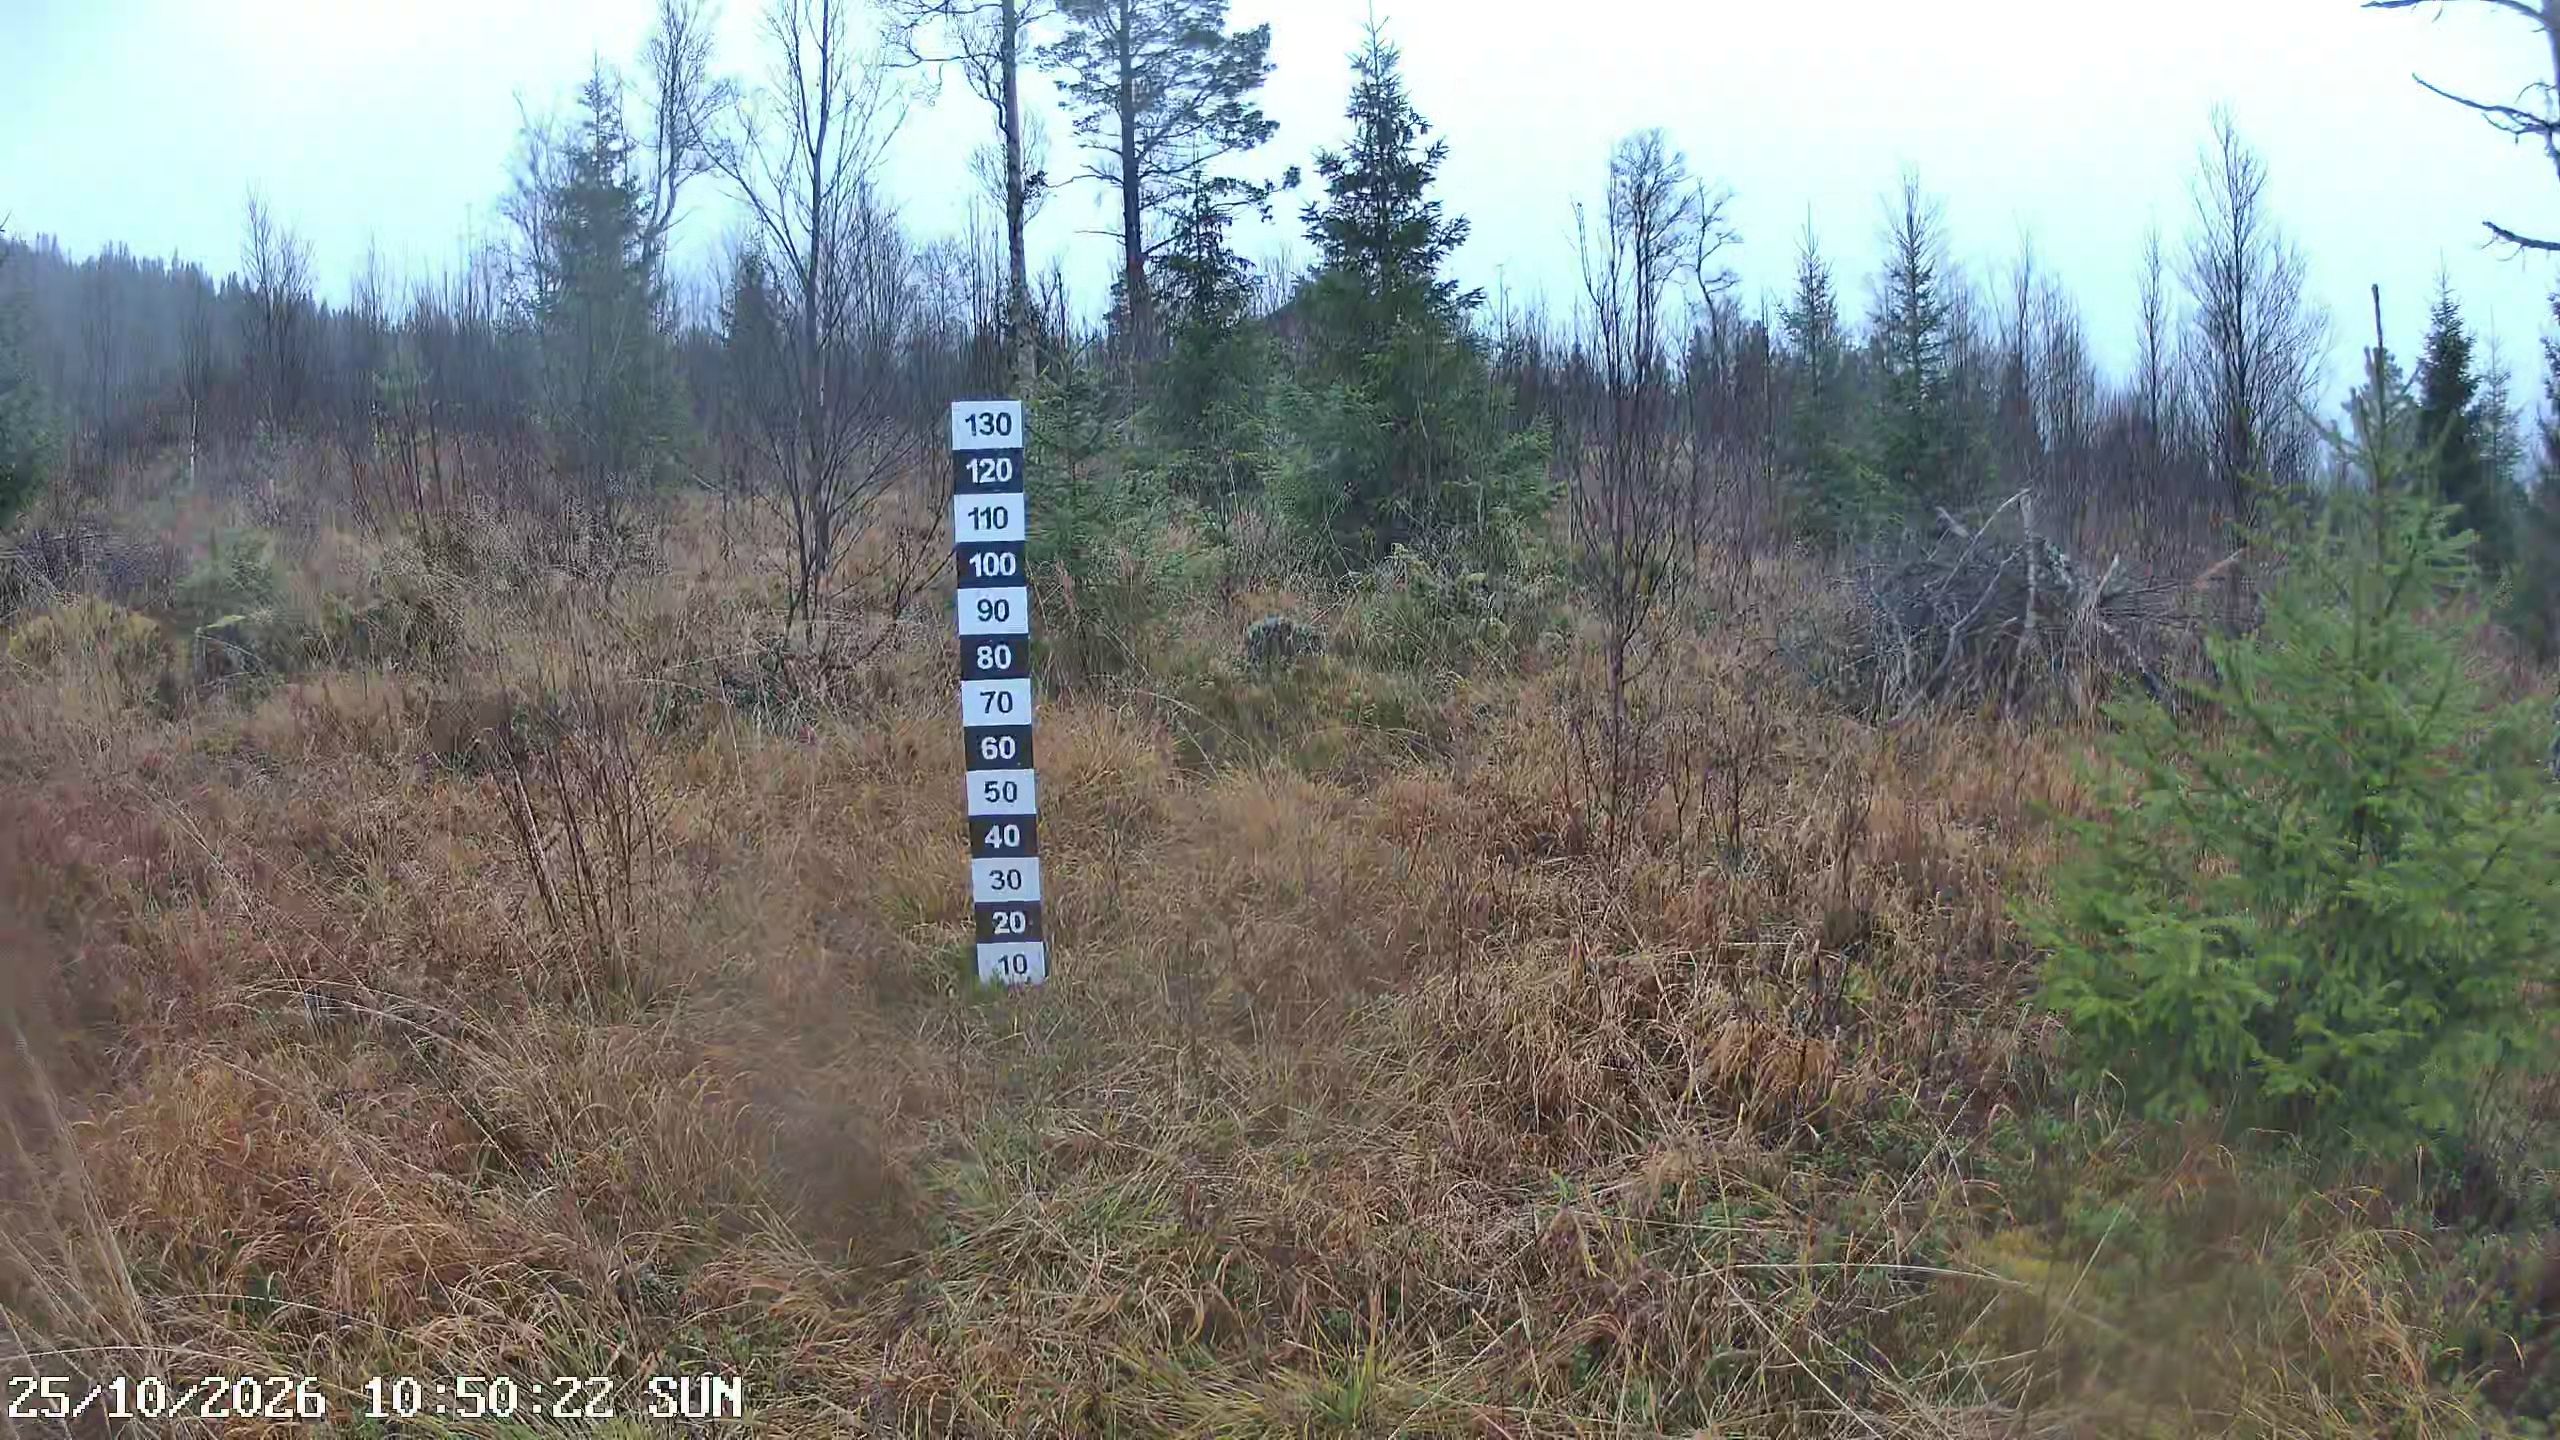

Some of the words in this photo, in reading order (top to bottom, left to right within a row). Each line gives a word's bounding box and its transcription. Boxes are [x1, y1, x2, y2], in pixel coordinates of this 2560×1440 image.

[965, 412, 1011, 436] 130
[966, 458, 1012, 483] 120
[968, 506, 1009, 530] 110
[970, 552, 1016, 577] 100
[978, 599, 1009, 622] 90
[977, 645, 1011, 669] 80
[980, 691, 1013, 714] 70
[981, 736, 1015, 759] 60
[985, 781, 1018, 803] 50
[985, 824, 1019, 848] 40
[989, 869, 1022, 891] 30
[993, 911, 1025, 934] 20
[998, 954, 1028, 976] 10
